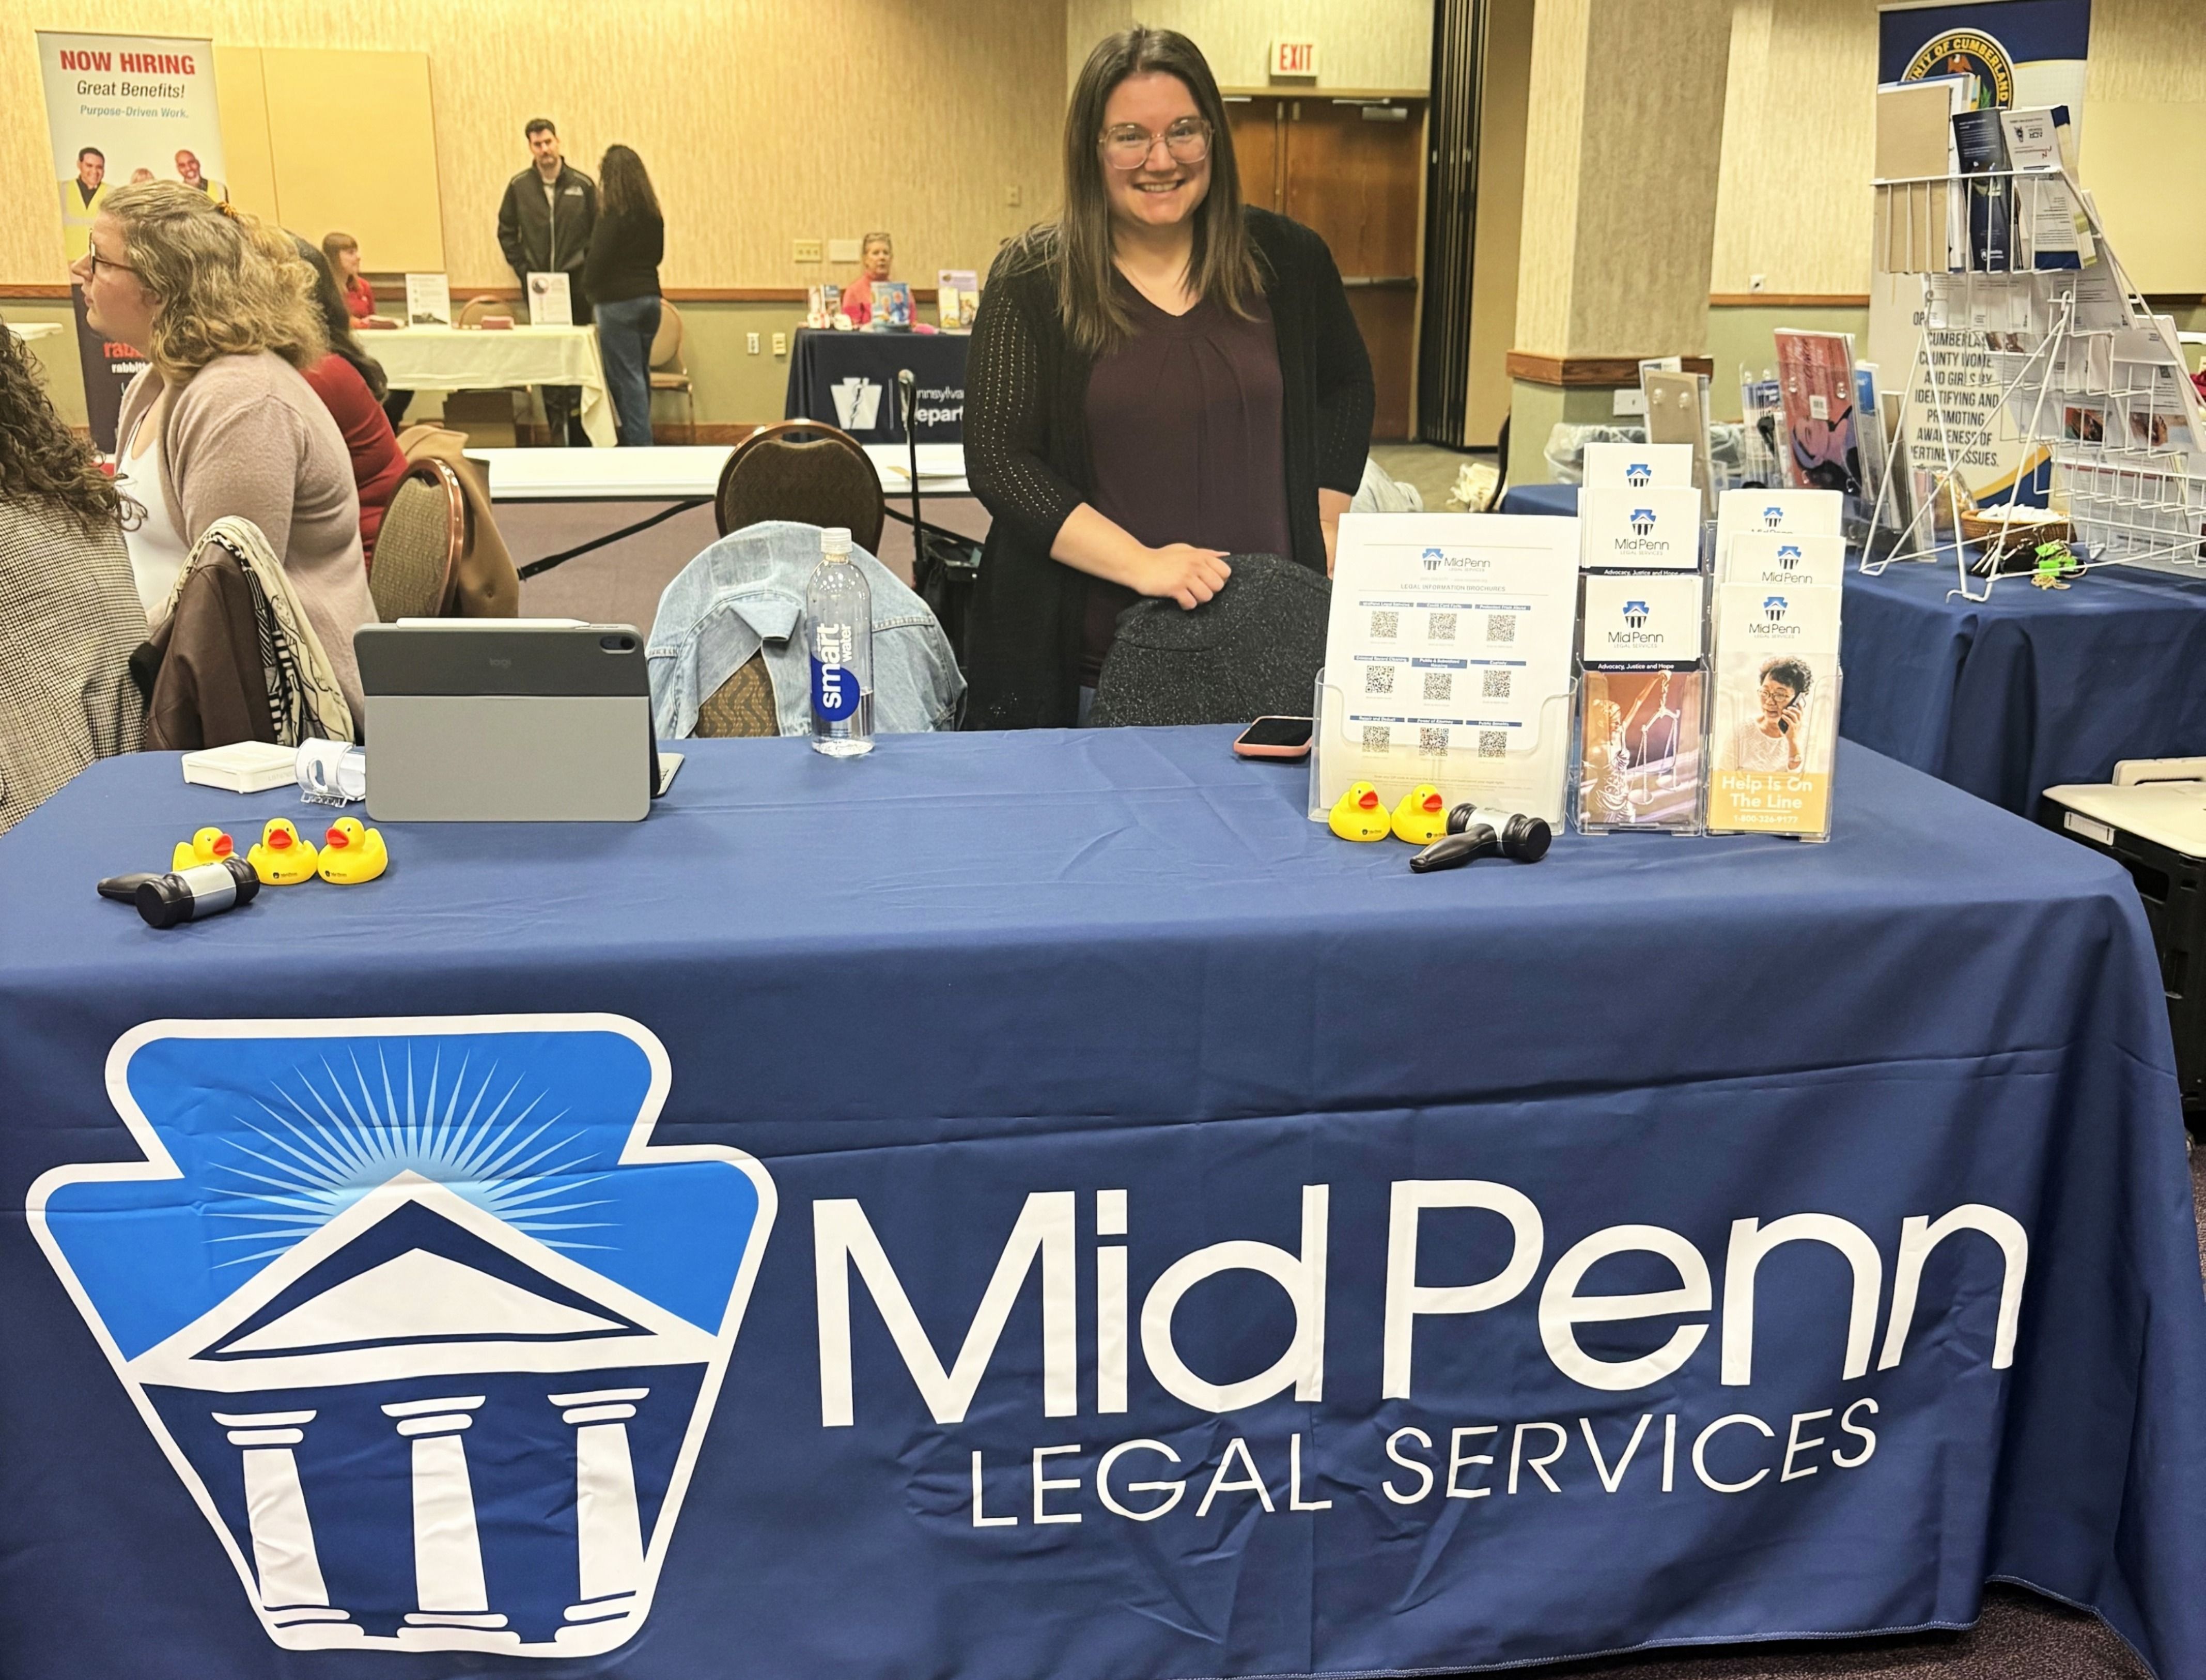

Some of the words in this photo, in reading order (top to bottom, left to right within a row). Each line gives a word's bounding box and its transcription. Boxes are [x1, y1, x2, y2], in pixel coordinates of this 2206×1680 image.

[60, 50, 111, 72] NOW
[119, 52, 195, 75] HIRING
[1280, 43, 1313, 71] EXIT
[1934, 41, 1950, 56] OF
[1953, 39, 2009, 101] CUMBERLAND
[77, 80, 116, 96] Great
[121, 82, 185, 98] Benefits!
[80, 104, 158, 117] Purpose-Driven
[161, 107, 189, 118] Work.
[1962, 352, 1994, 368] WOME
[1948, 371, 1976, 386] GIRS
[1978, 393, 1999, 408] AND
[1980, 432, 1992, 446] OF
[1911, 446, 1961, 462] ERTINENT
[1963, 450, 1999, 467] SSUES.
[840, 624, 852, 662] water
[490, 658, 511, 669] logi
[817, 623, 842, 709] smart
[1721, 775, 1762, 794] Help
[1768, 776, 1781, 791] Is
[1787, 776, 1812, 792] On
[1730, 793, 1761, 807] The
[1767, 794, 1803, 809] Line
[1733, 815, 1798, 823] 1-800-326-9177
[971, 1433, 1332, 1528] LEGAL
[1381, 1397, 1879, 1505] SERVICES
